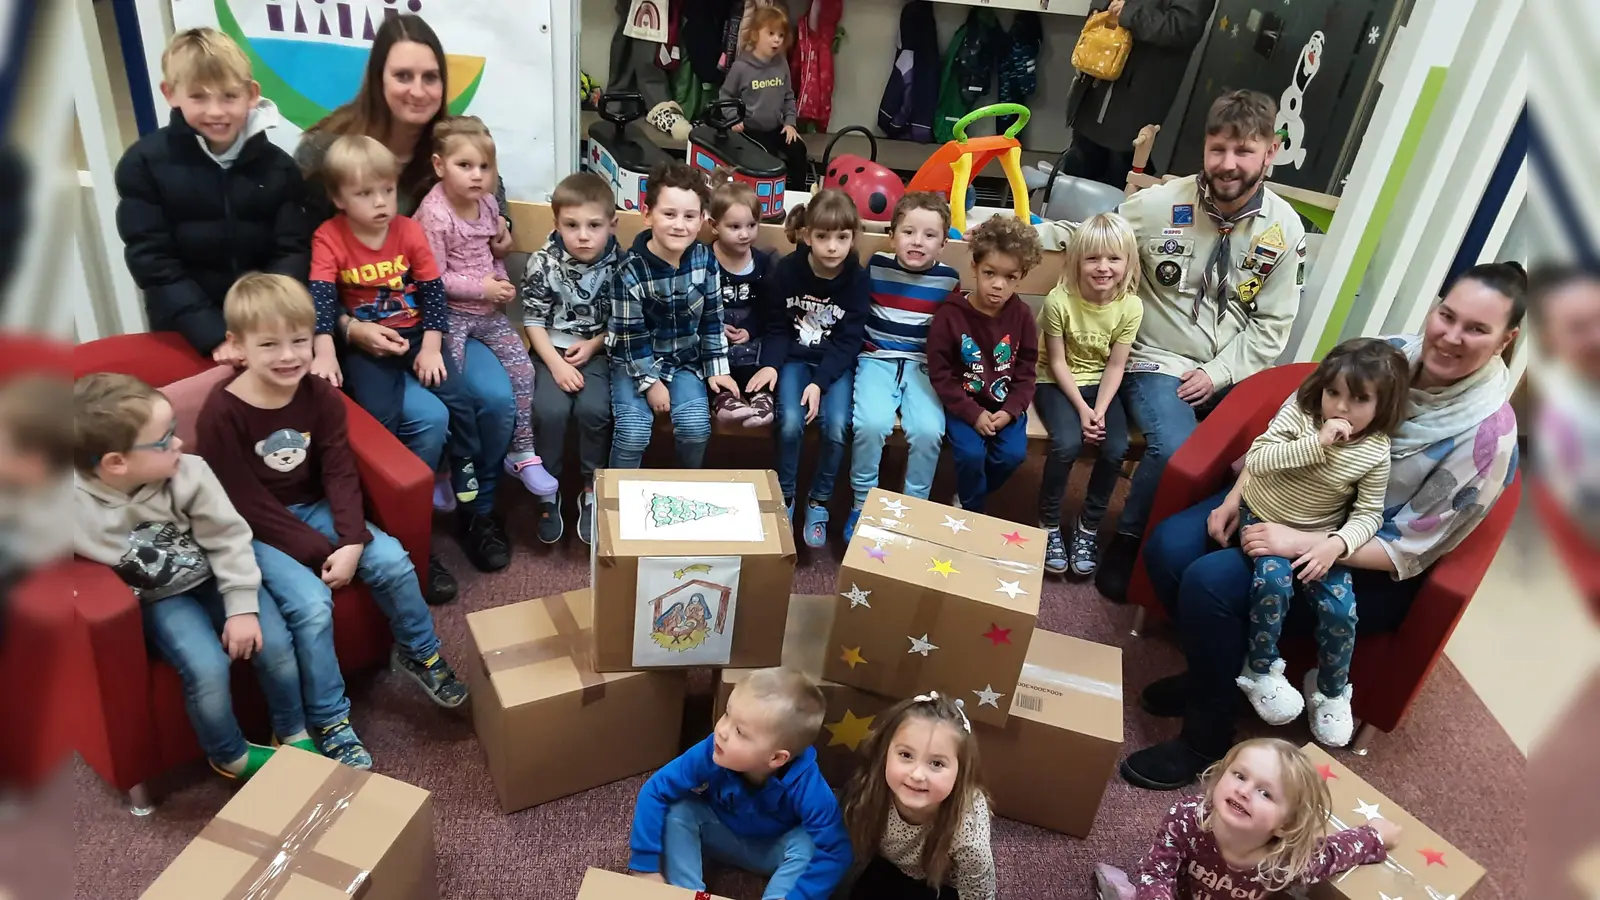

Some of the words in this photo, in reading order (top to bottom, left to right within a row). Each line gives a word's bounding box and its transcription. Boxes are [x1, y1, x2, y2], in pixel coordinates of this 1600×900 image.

[751, 77, 785, 90] Bench.
[341, 254, 409, 285] WORK
[786, 295, 846, 320] RAINBOW
